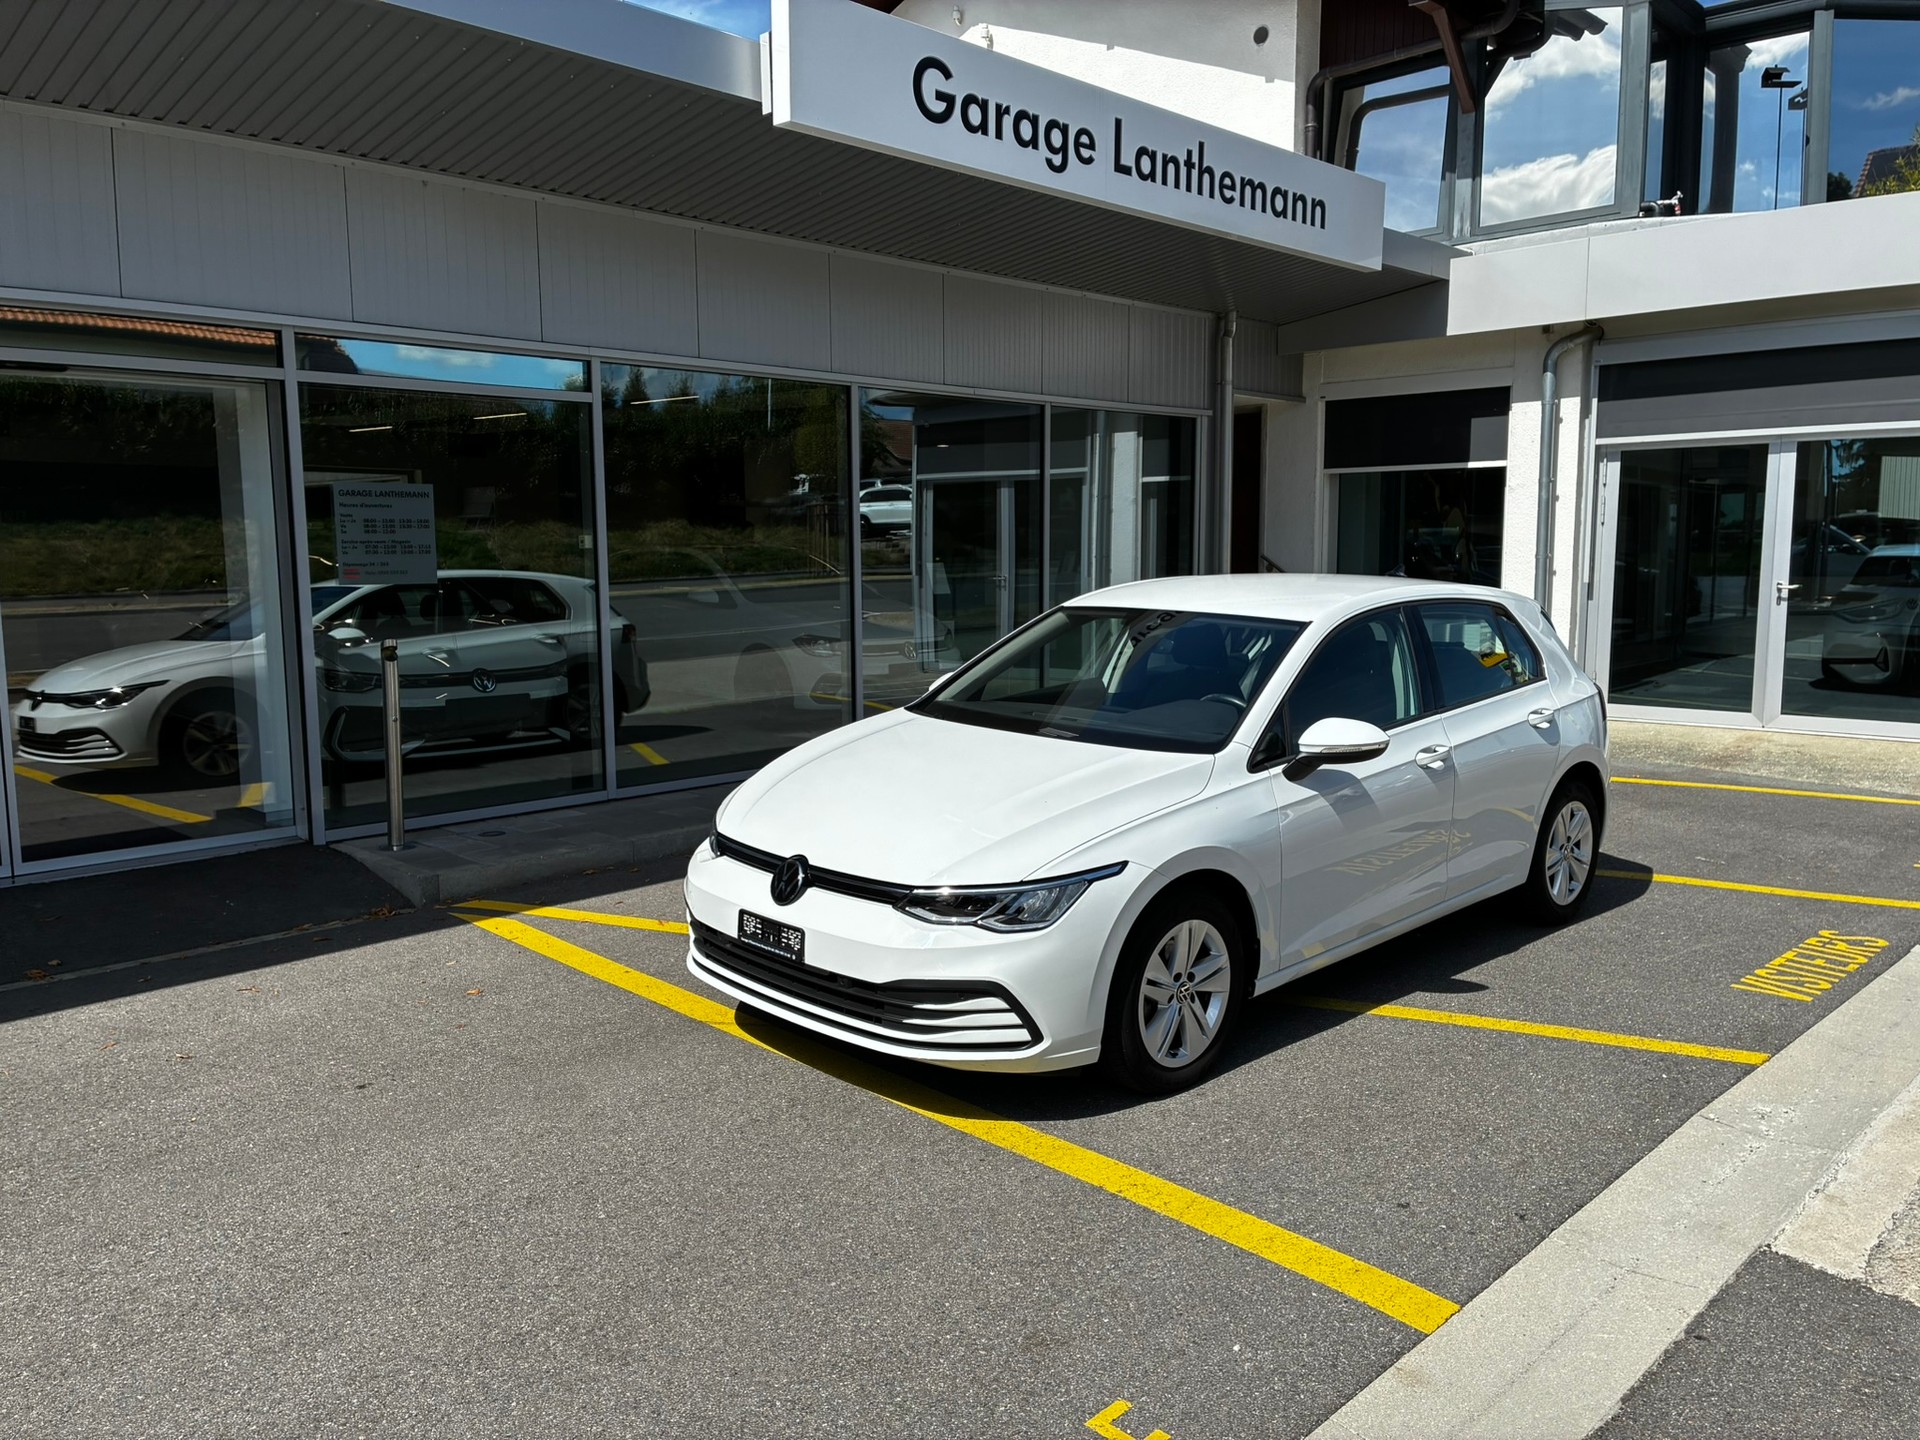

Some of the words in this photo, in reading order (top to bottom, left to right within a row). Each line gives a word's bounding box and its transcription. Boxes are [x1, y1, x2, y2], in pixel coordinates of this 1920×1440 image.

[912, 55, 1097, 173] Garage
[1113, 116, 1327, 230] Lanthemann
[338, 489, 373, 498] GARAGE
[374, 489, 430, 499] LANTHEMANN
[1730, 929, 1890, 1003] VISITEURS
